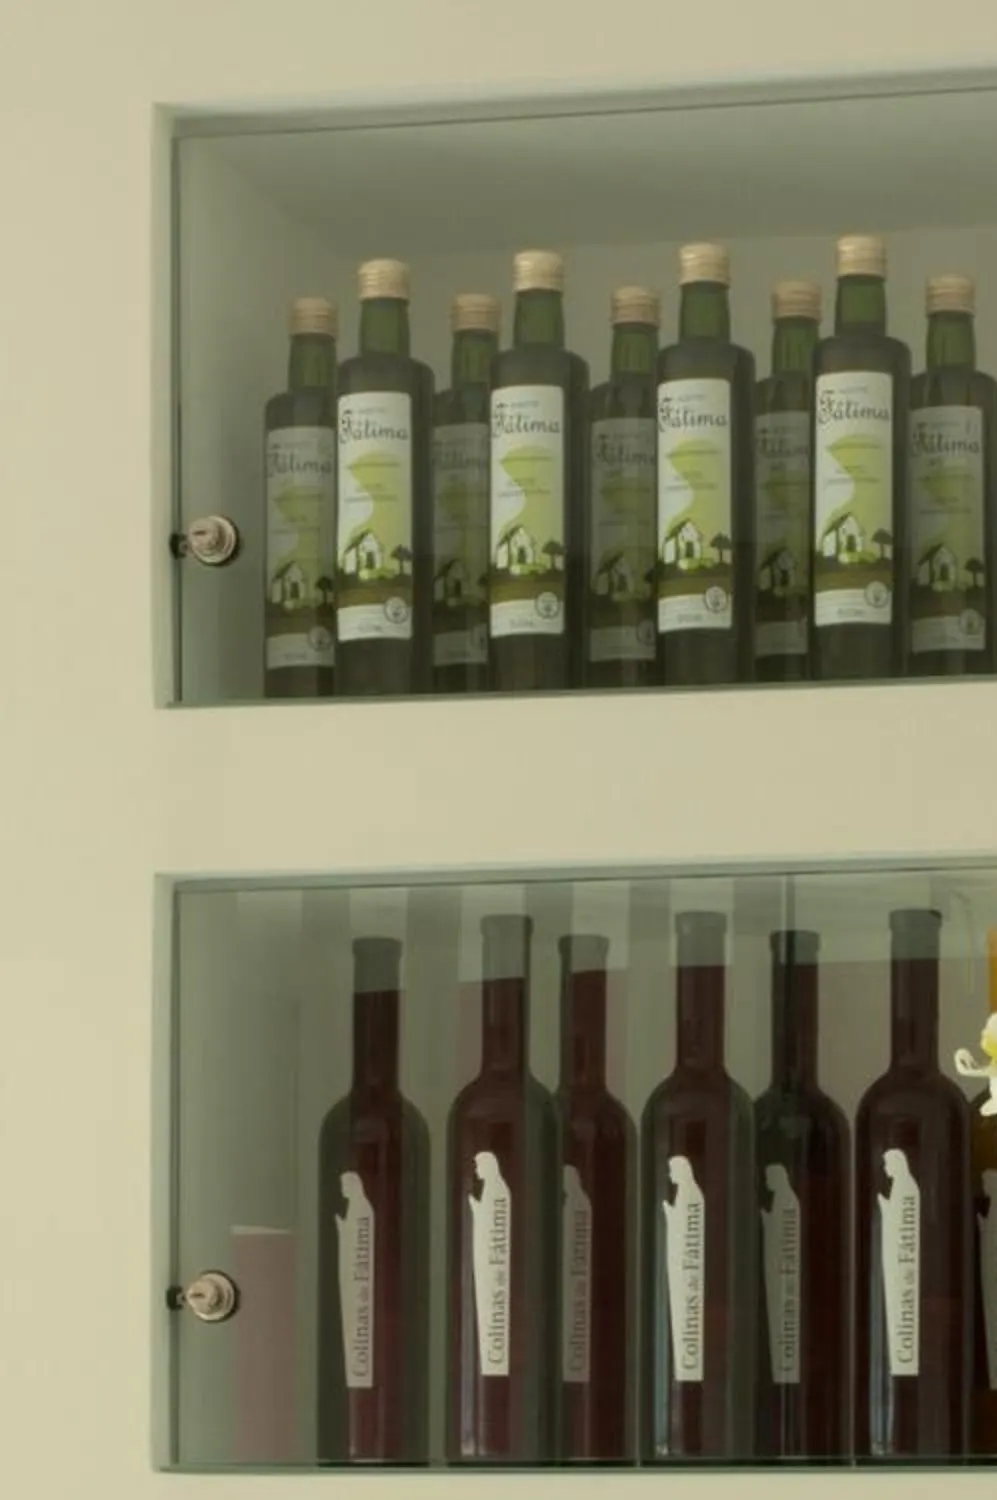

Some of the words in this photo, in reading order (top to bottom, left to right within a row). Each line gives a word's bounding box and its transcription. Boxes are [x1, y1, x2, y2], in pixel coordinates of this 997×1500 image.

[488, 1290, 505, 1363] Colinas
[682, 1296, 699, 1369] Colinas
[896, 1289, 915, 1363] Colinas
